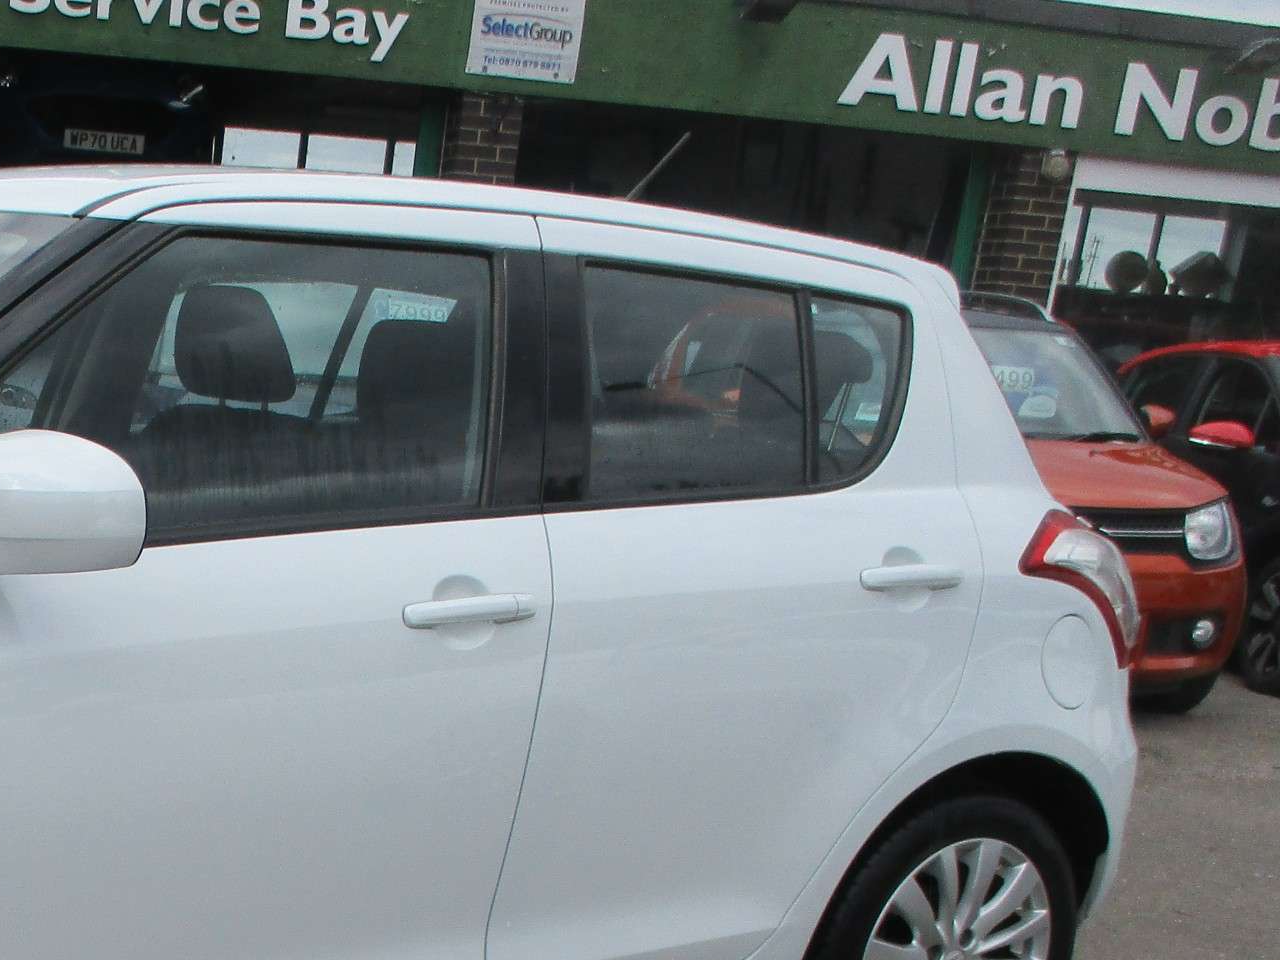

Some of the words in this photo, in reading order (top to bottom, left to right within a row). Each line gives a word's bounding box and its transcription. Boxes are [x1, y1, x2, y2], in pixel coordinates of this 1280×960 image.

[285, 0, 409, 63] Bay
[480, 15, 573, 50] SelectGroup
[837, 33, 1084, 129] Allan
